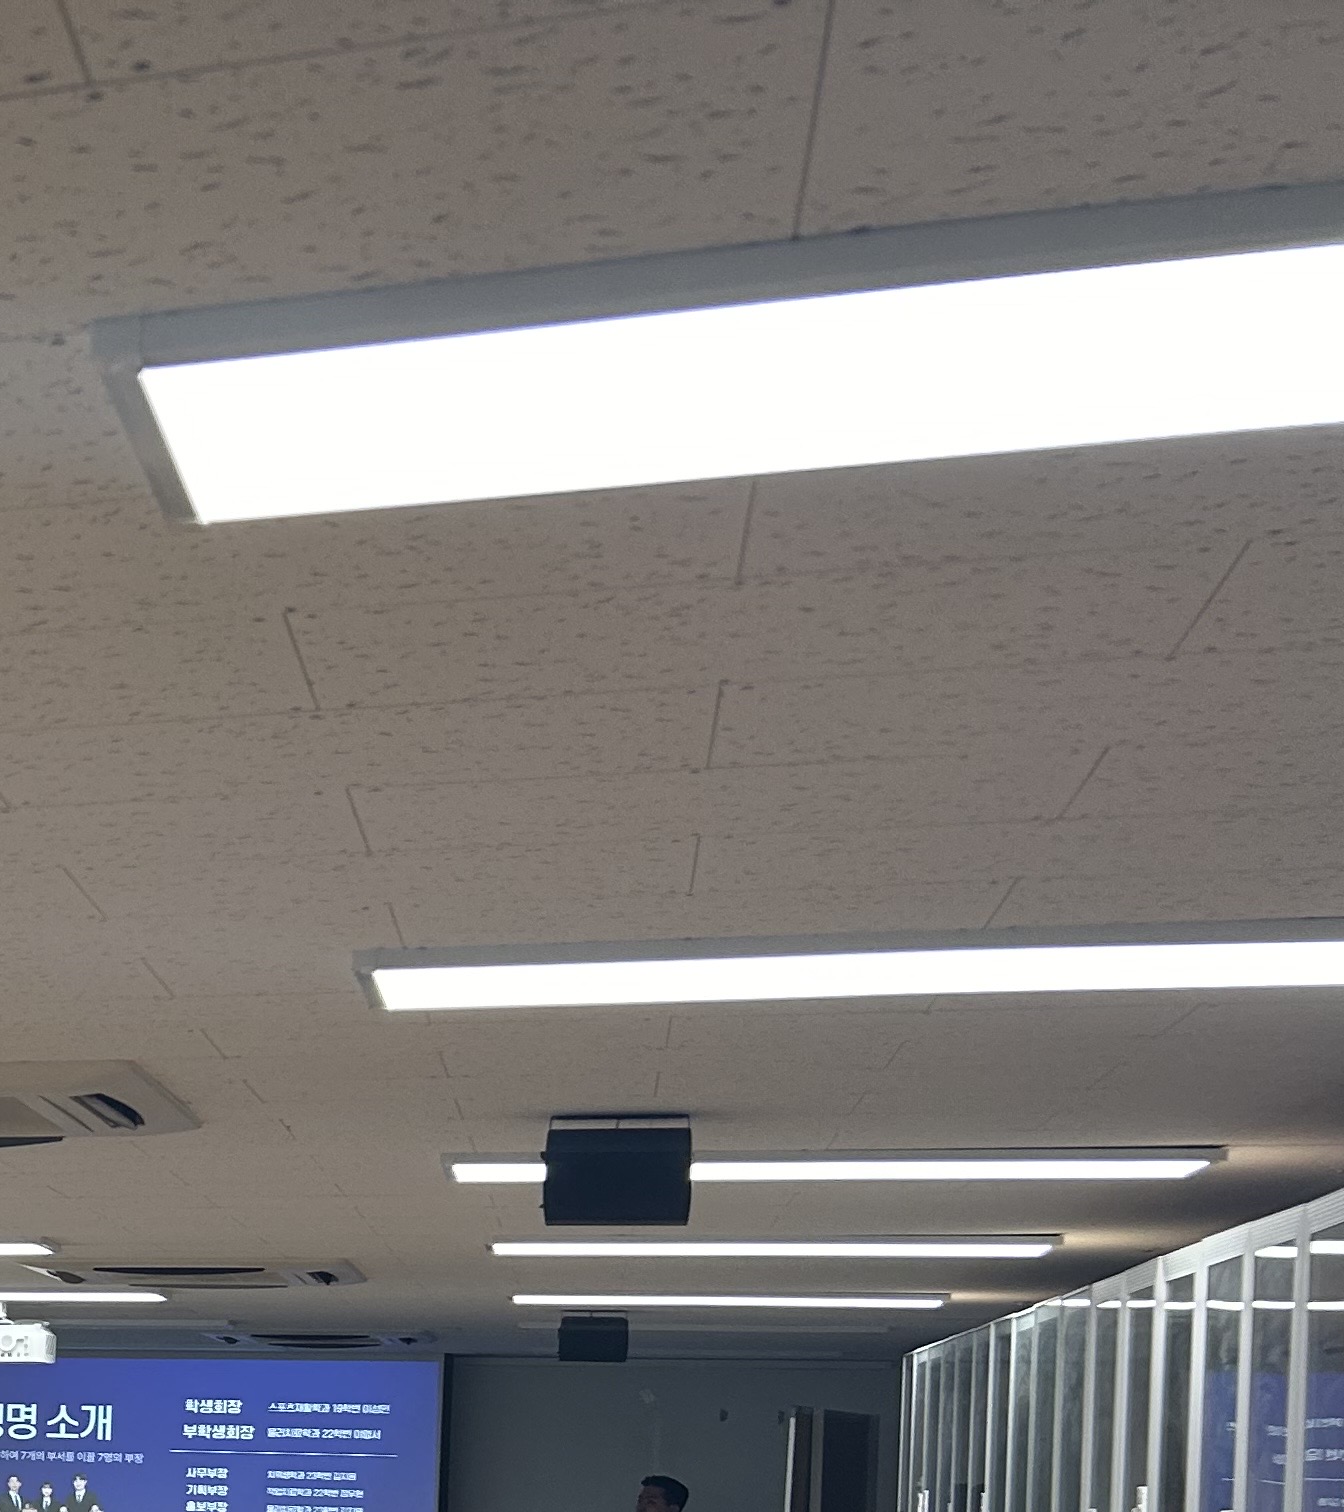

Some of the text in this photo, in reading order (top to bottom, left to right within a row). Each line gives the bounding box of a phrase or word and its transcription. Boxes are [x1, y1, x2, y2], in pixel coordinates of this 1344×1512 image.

[184, 1398, 243, 1414] 학생회장
[46, 1404, 113, 1441] 소개
[182, 1424, 255, 1440] 부학생회장
[20, 1451, 45, 1461] 7개의
[46, 1451, 74, 1462] 부서를
[124, 1453, 144, 1464] 부장
[185, 1468, 228, 1479] 사무부장
[185, 1484, 228, 1496] 기획부장
[185, 1501, 228, 1512] 홍보부장
